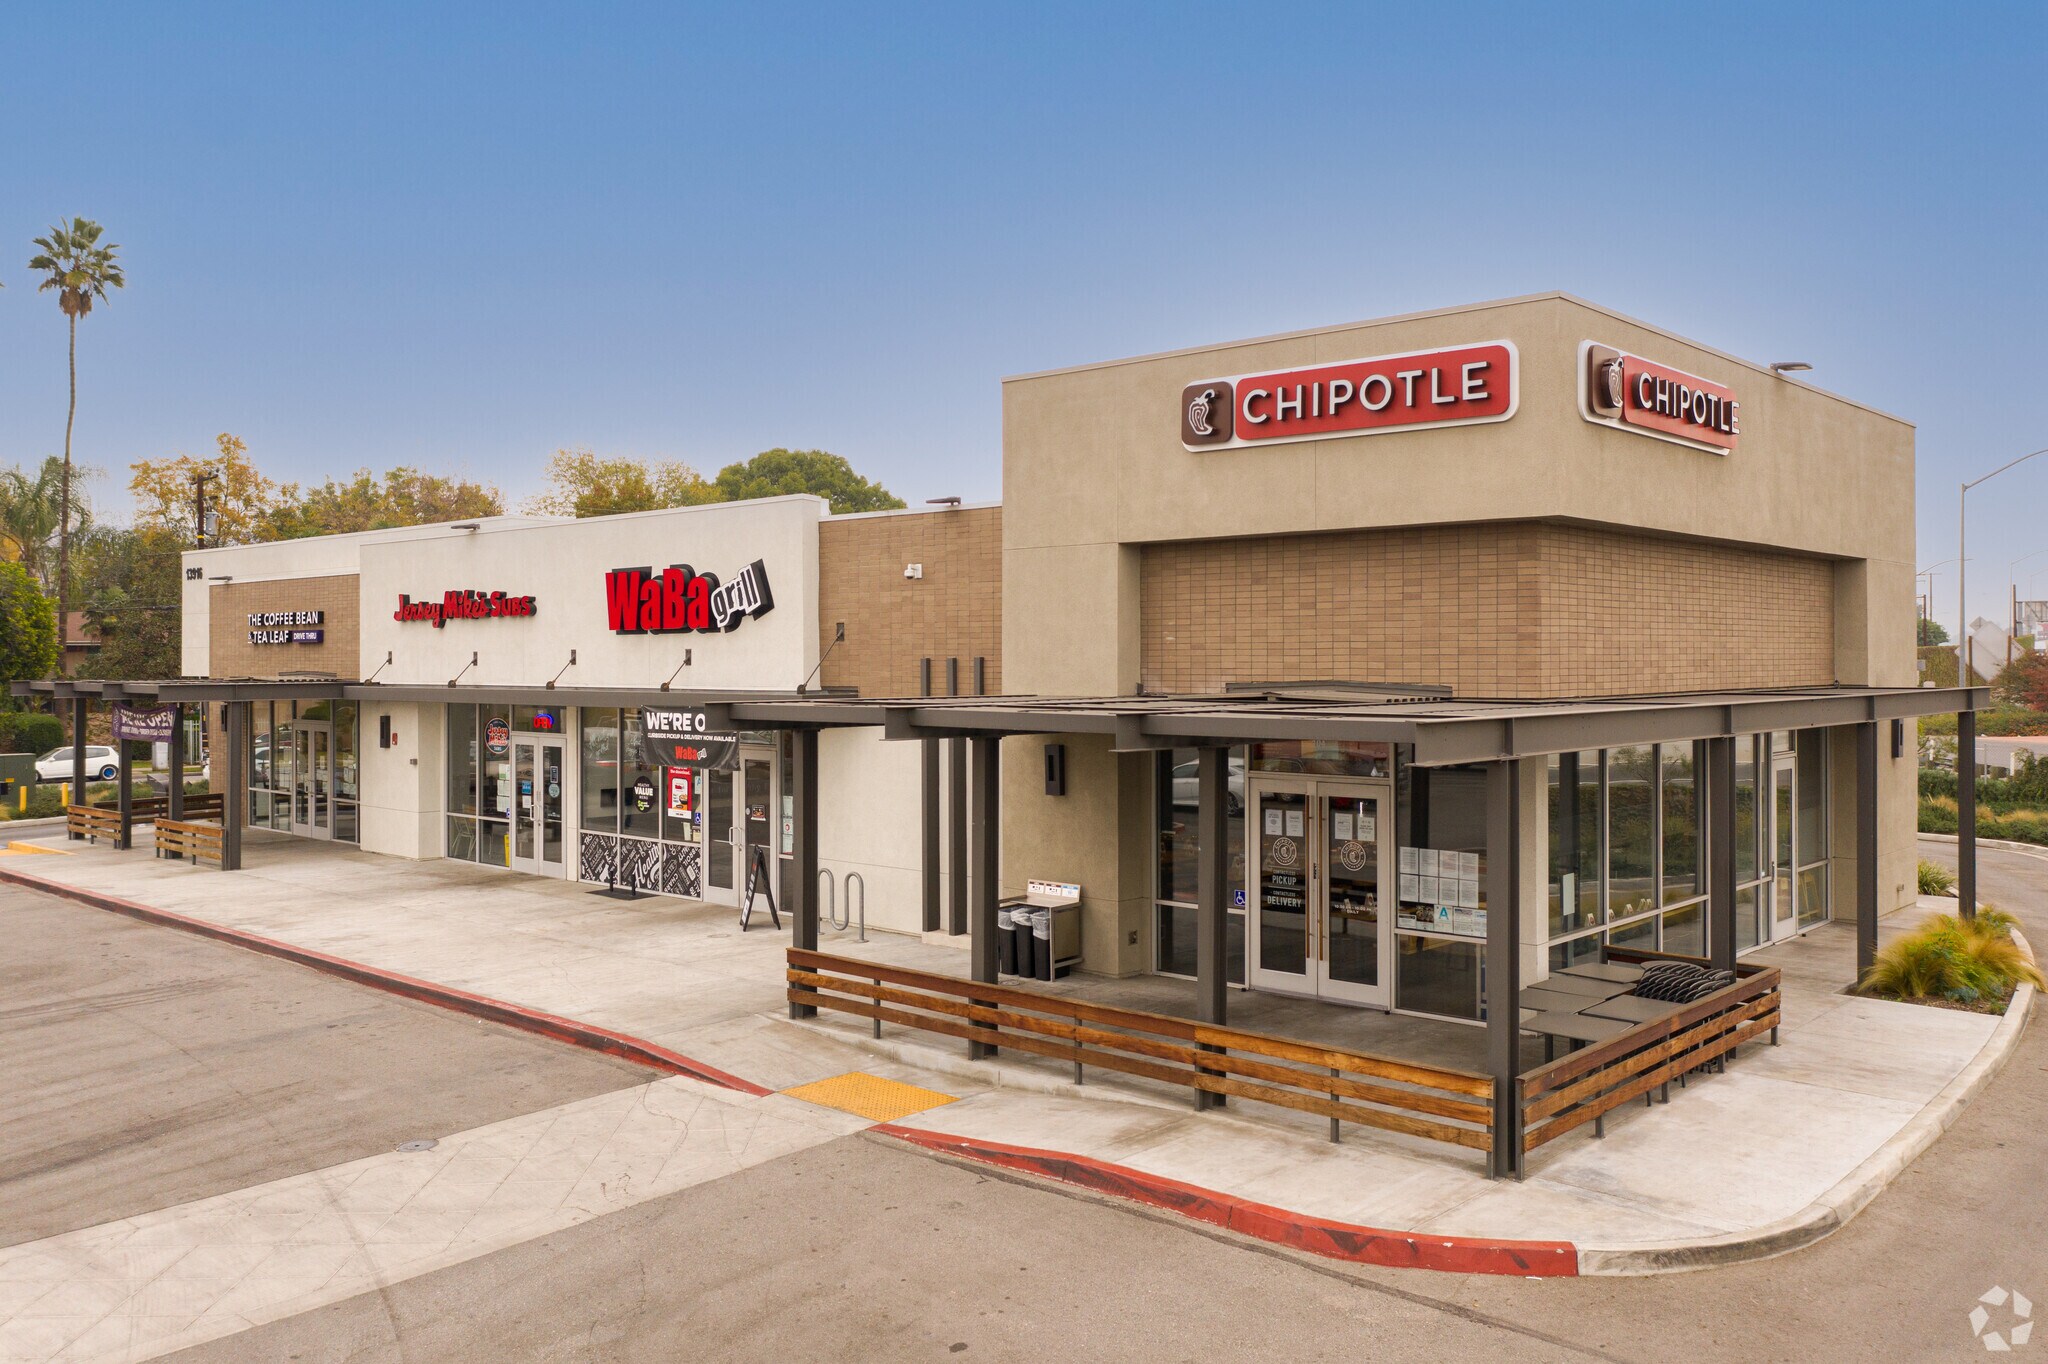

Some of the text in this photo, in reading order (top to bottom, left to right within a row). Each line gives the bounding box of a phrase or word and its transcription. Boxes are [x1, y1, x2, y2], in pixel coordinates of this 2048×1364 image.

[1242, 361, 1491, 424] CHIPOTLE
[1635, 371, 1740, 434] CHIPOTLE
[605, 565, 762, 632] WaBa grill
[394, 594, 441, 629] Jersey
[442, 590, 489, 619] Mike's
[247, 611, 319, 626] THE COFFEE BEAN
[253, 631, 268, 644] TEA
[270, 630, 289, 643] LEAF
[293, 632, 317, 640] DRIVE THRU
[533, 717, 552, 729] OPEN
[646, 712, 692, 731] WE'RE
[675, 745, 698, 760] WaBa
[634, 786, 654, 797] VALUE
[1272, 874, 1297, 886] PICKUP
[1267, 896, 1302, 908] DELIVERY
[1439, 906, 1449, 920] A
